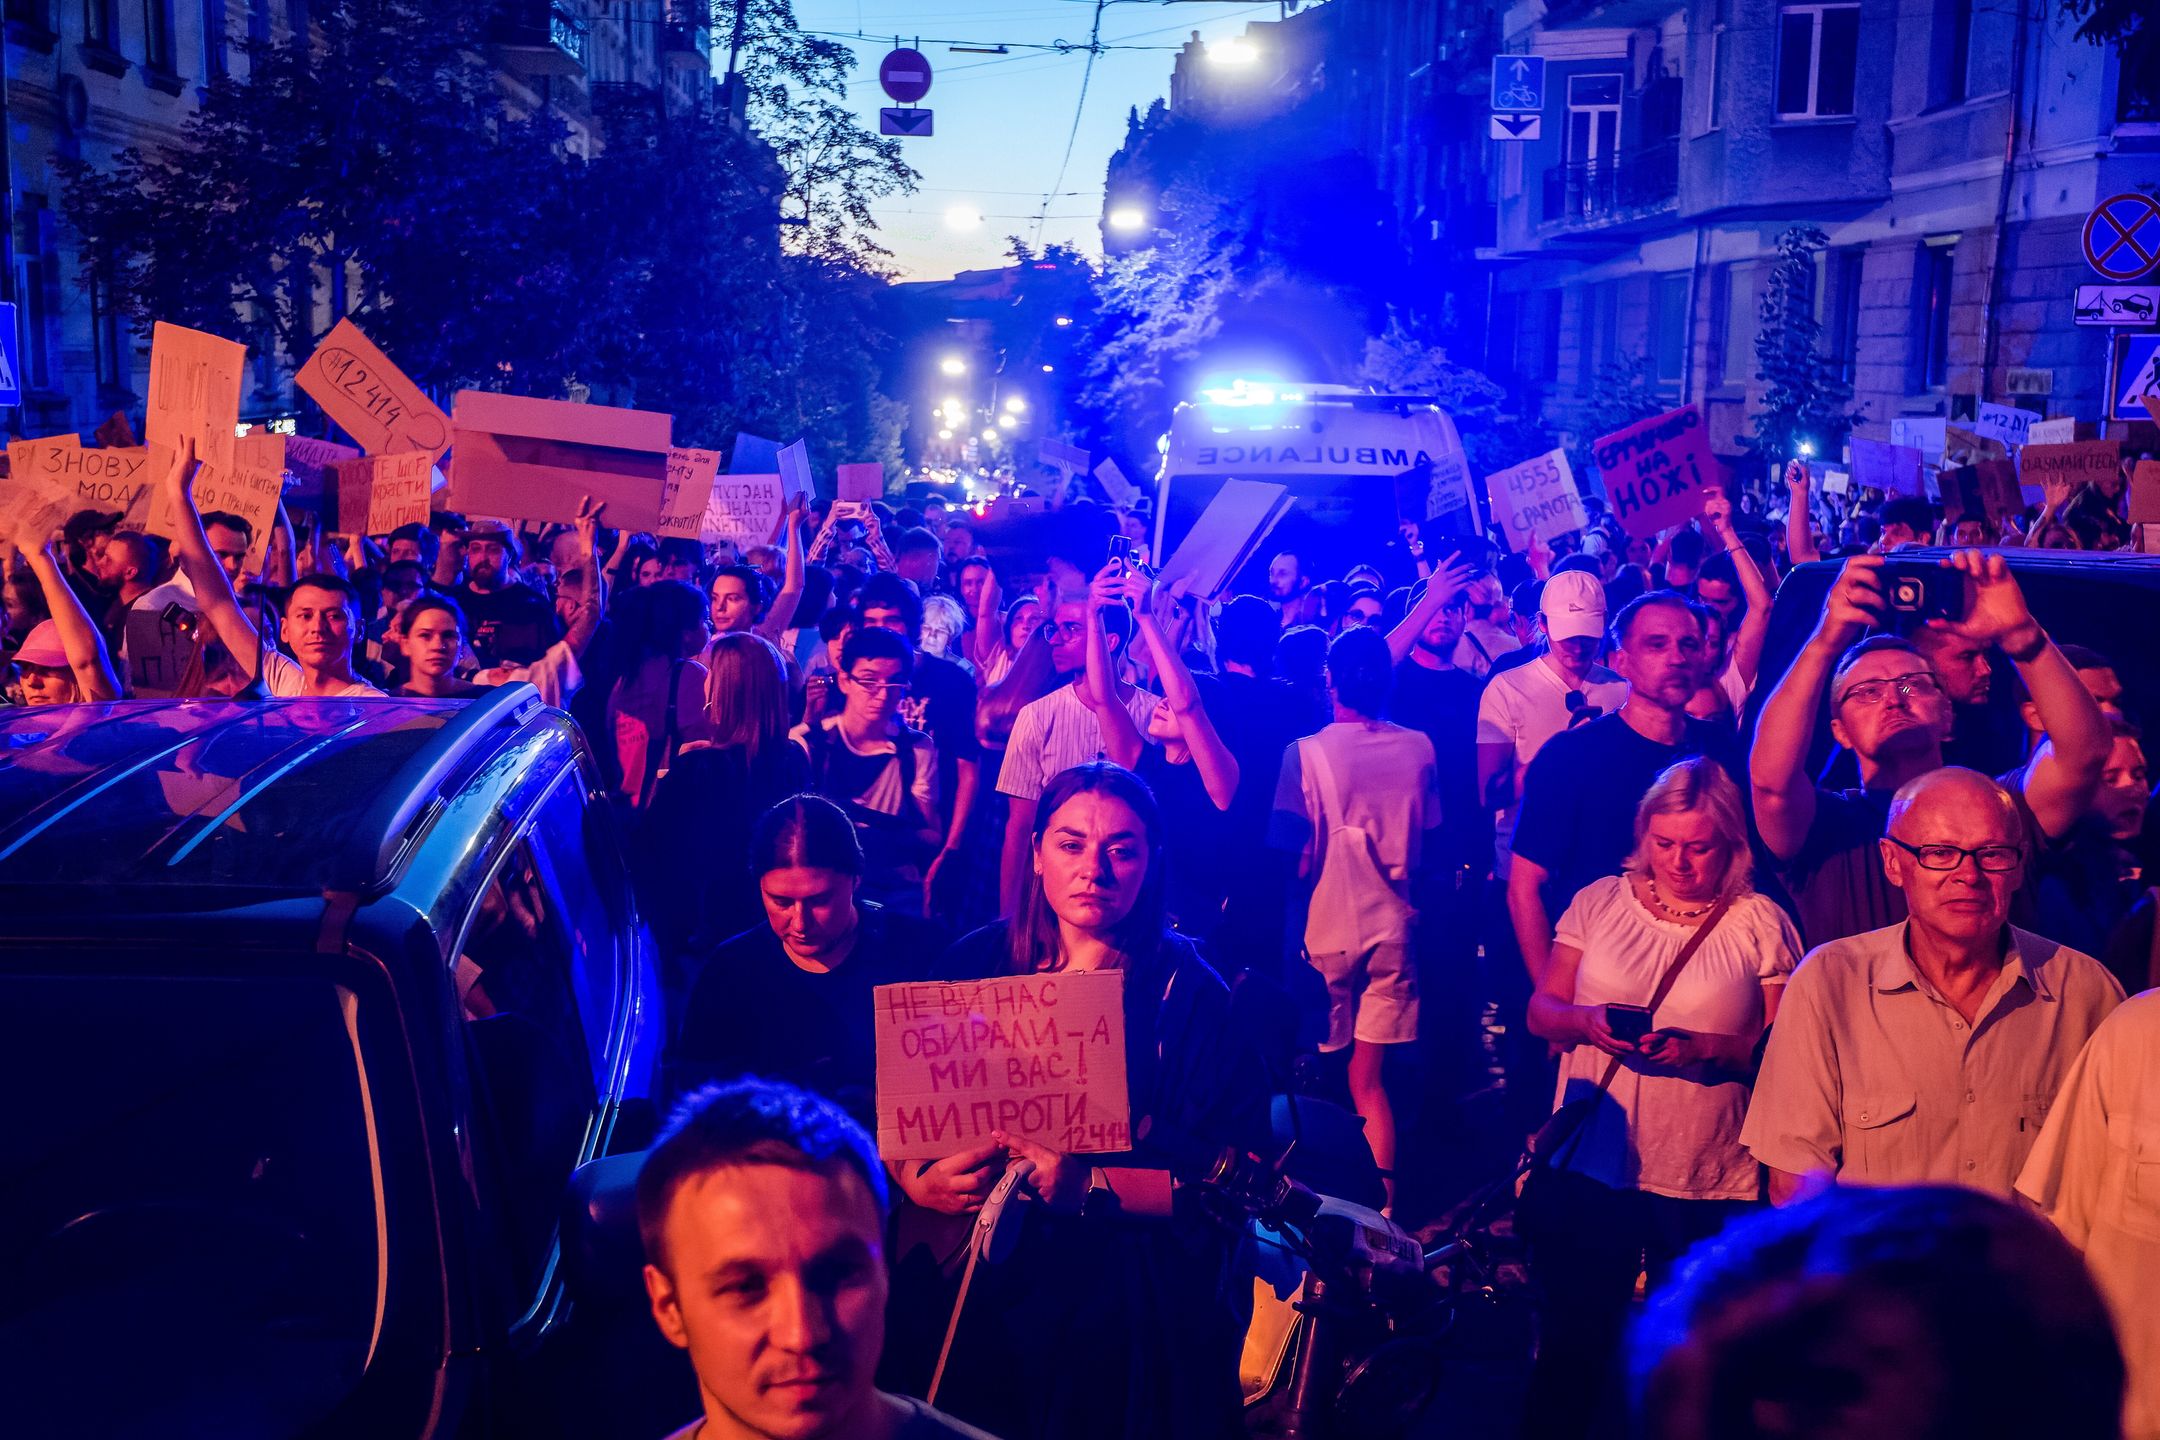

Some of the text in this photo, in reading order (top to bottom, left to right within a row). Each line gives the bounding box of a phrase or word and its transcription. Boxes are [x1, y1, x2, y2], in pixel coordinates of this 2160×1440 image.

[327, 355, 402, 427] #12414
[42, 447, 146, 479] ЗНОВУ
[1507, 458, 1561, 495] 4555
[77, 479, 131, 504] МОД
[658, 511, 703, 534] ОКРАТІЇ!
[1512, 492, 1581, 531] СРАМОТА
[888, 980, 1059, 1025] НЕ ВИ НАС
[900, 1017, 1060, 1059] ОБИРАЛИ
[928, 1058, 989, 1093] МИ
[896, 1091, 1088, 1146] МИ ПРОТИ
[1058, 1121, 1129, 1152] 12414
